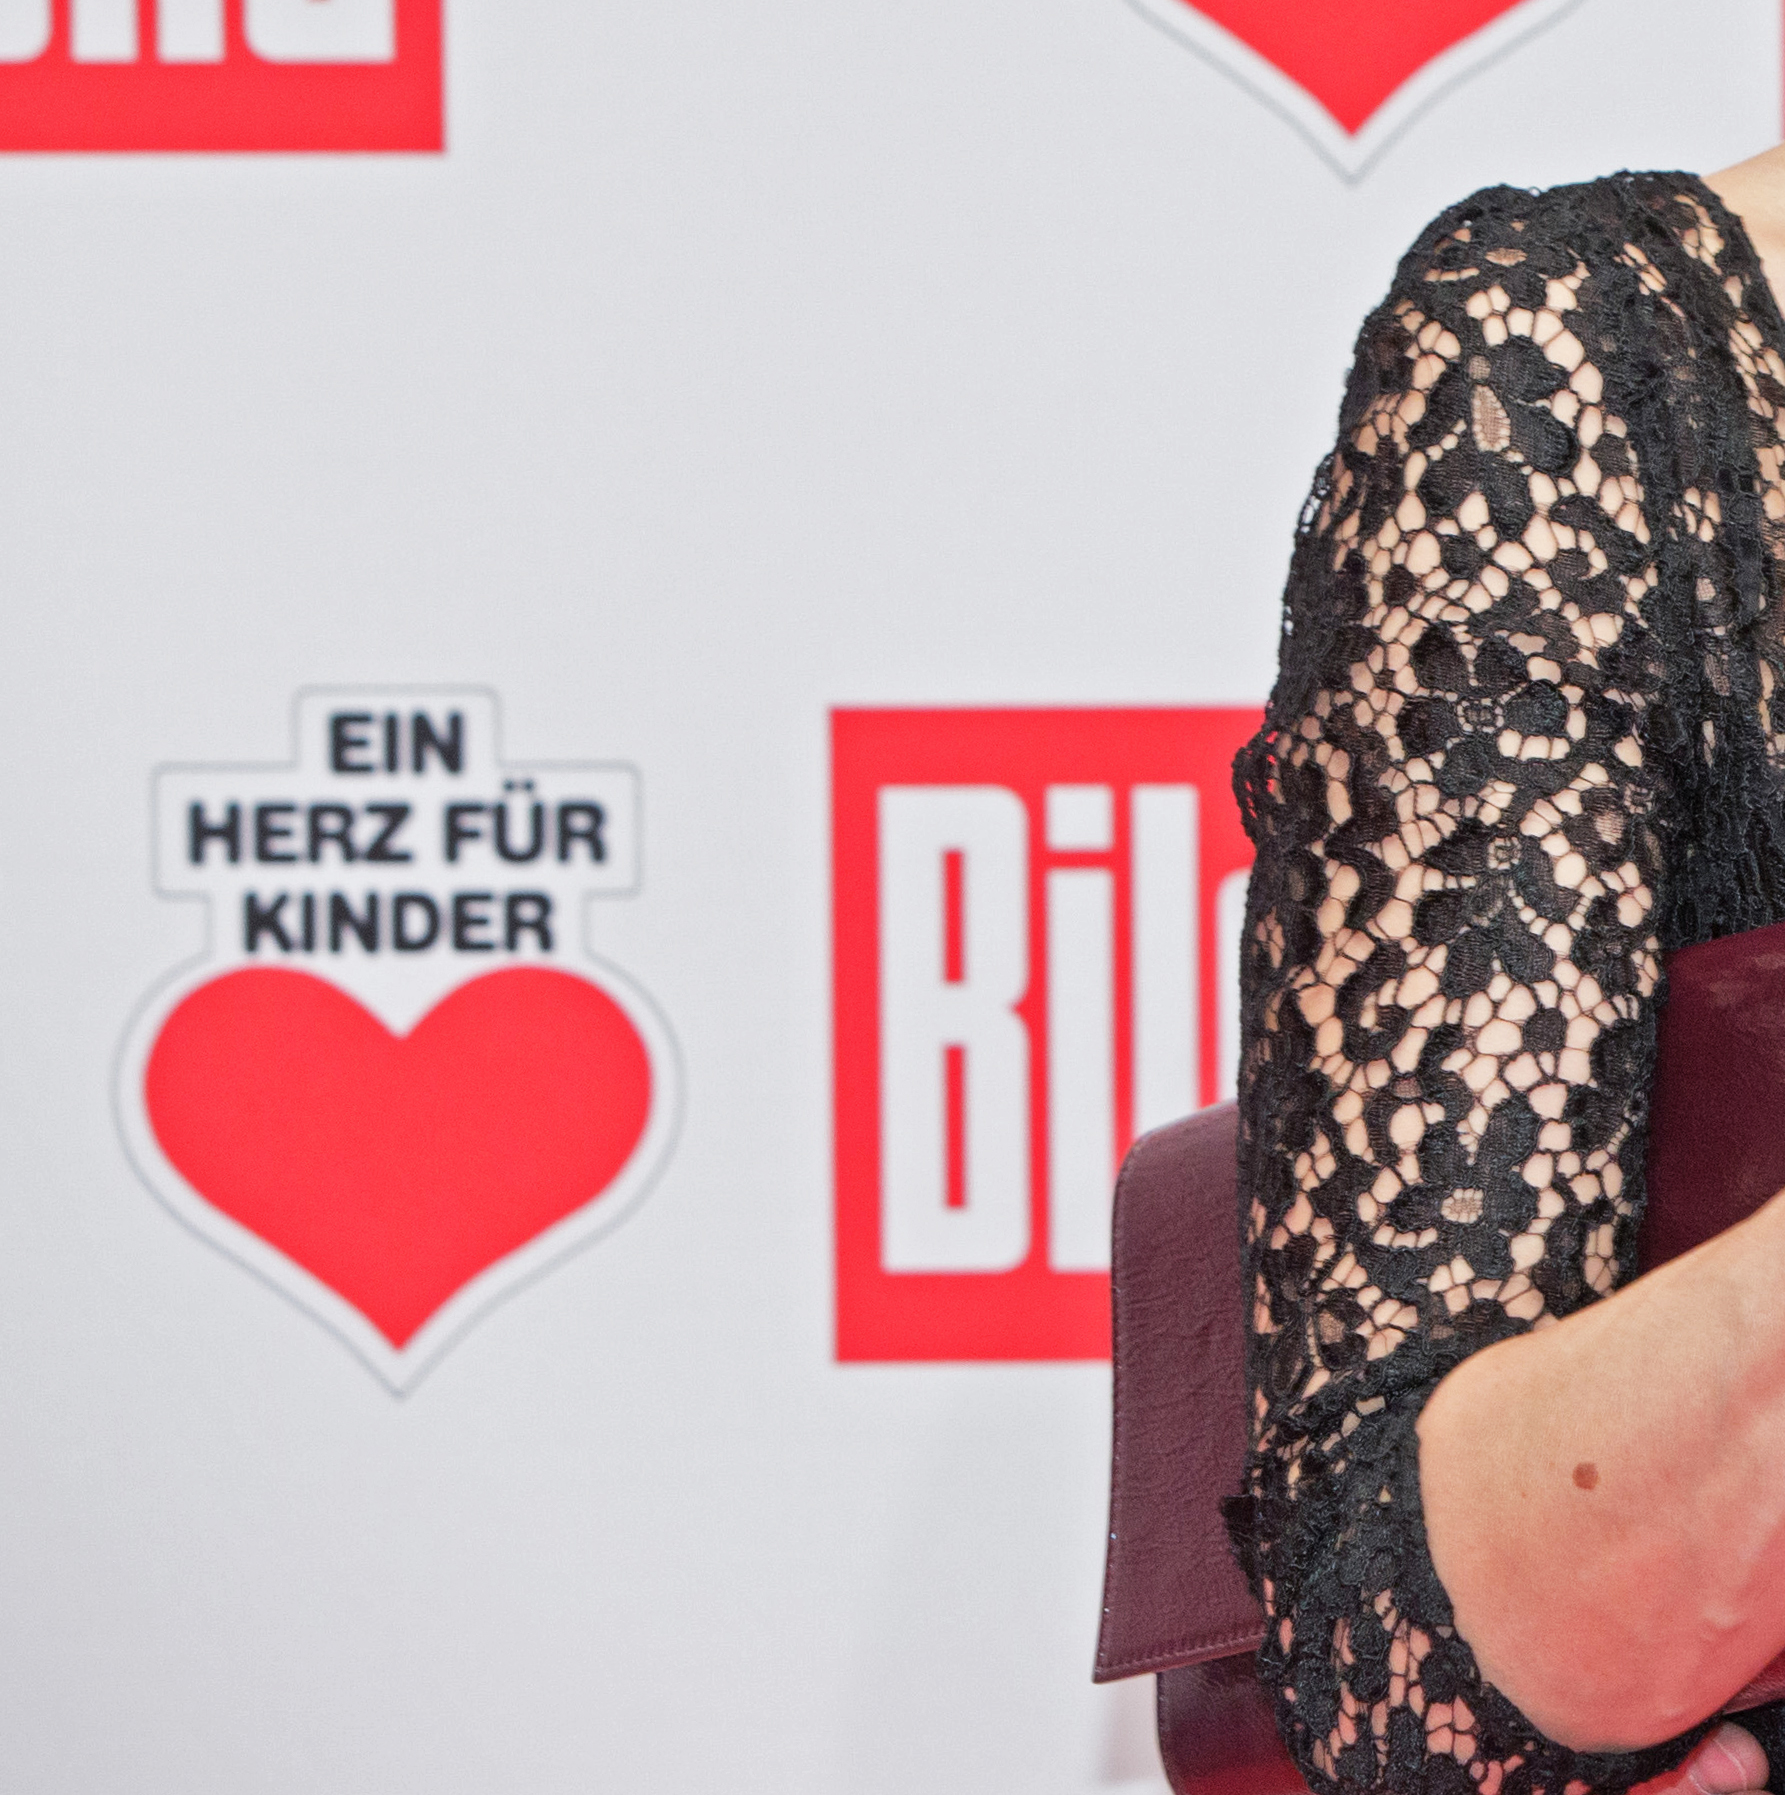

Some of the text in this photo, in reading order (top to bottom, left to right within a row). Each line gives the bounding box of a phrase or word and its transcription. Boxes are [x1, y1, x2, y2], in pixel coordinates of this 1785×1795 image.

[329, 712, 465, 775] EIN
[188, 781, 607, 866] HERZ FÜR
[242, 892, 555, 954] KINDER
[877, 783, 1254, 1274] Bil
